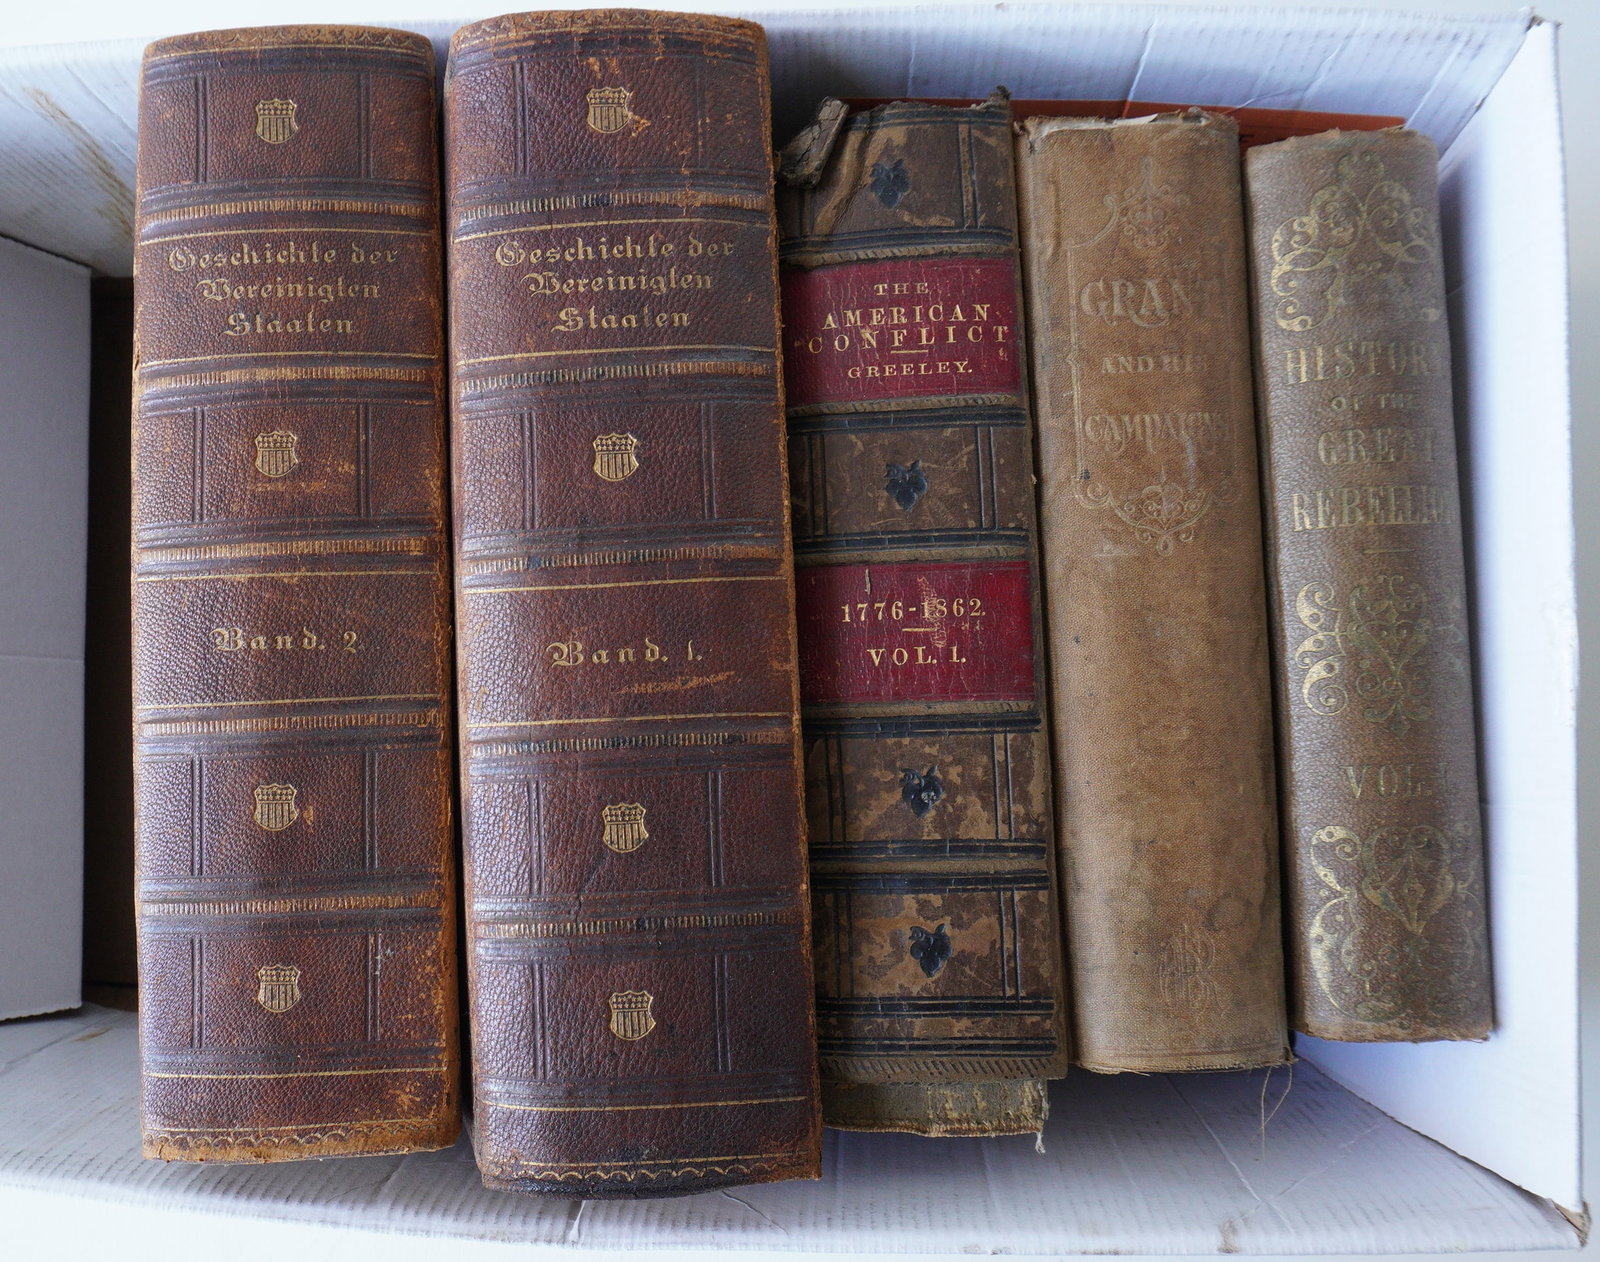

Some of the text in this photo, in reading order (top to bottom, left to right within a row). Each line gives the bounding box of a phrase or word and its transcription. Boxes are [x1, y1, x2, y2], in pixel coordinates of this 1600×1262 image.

[167, 242, 398, 272] Geschichte der
[495, 234, 736, 267] Geschichte der
[195, 276, 381, 303] Vereinigten
[520, 267, 713, 298] Vereinigten
[874, 282, 929, 296] THE
[219, 311, 353, 337] Staaten
[551, 305, 690, 332] Staaten
[822, 304, 990, 330] AMERICAN
[808, 325, 1007, 354] CONFLICT
[847, 360, 973, 379] GREELEY.
[1101, 356, 1155, 374] AND
[841, 598, 986, 623] 1776-1862.
[208, 626, 326, 652] Band.
[545, 637, 669, 668] Band.
[867, 645, 967, 667] VOL. 1.
